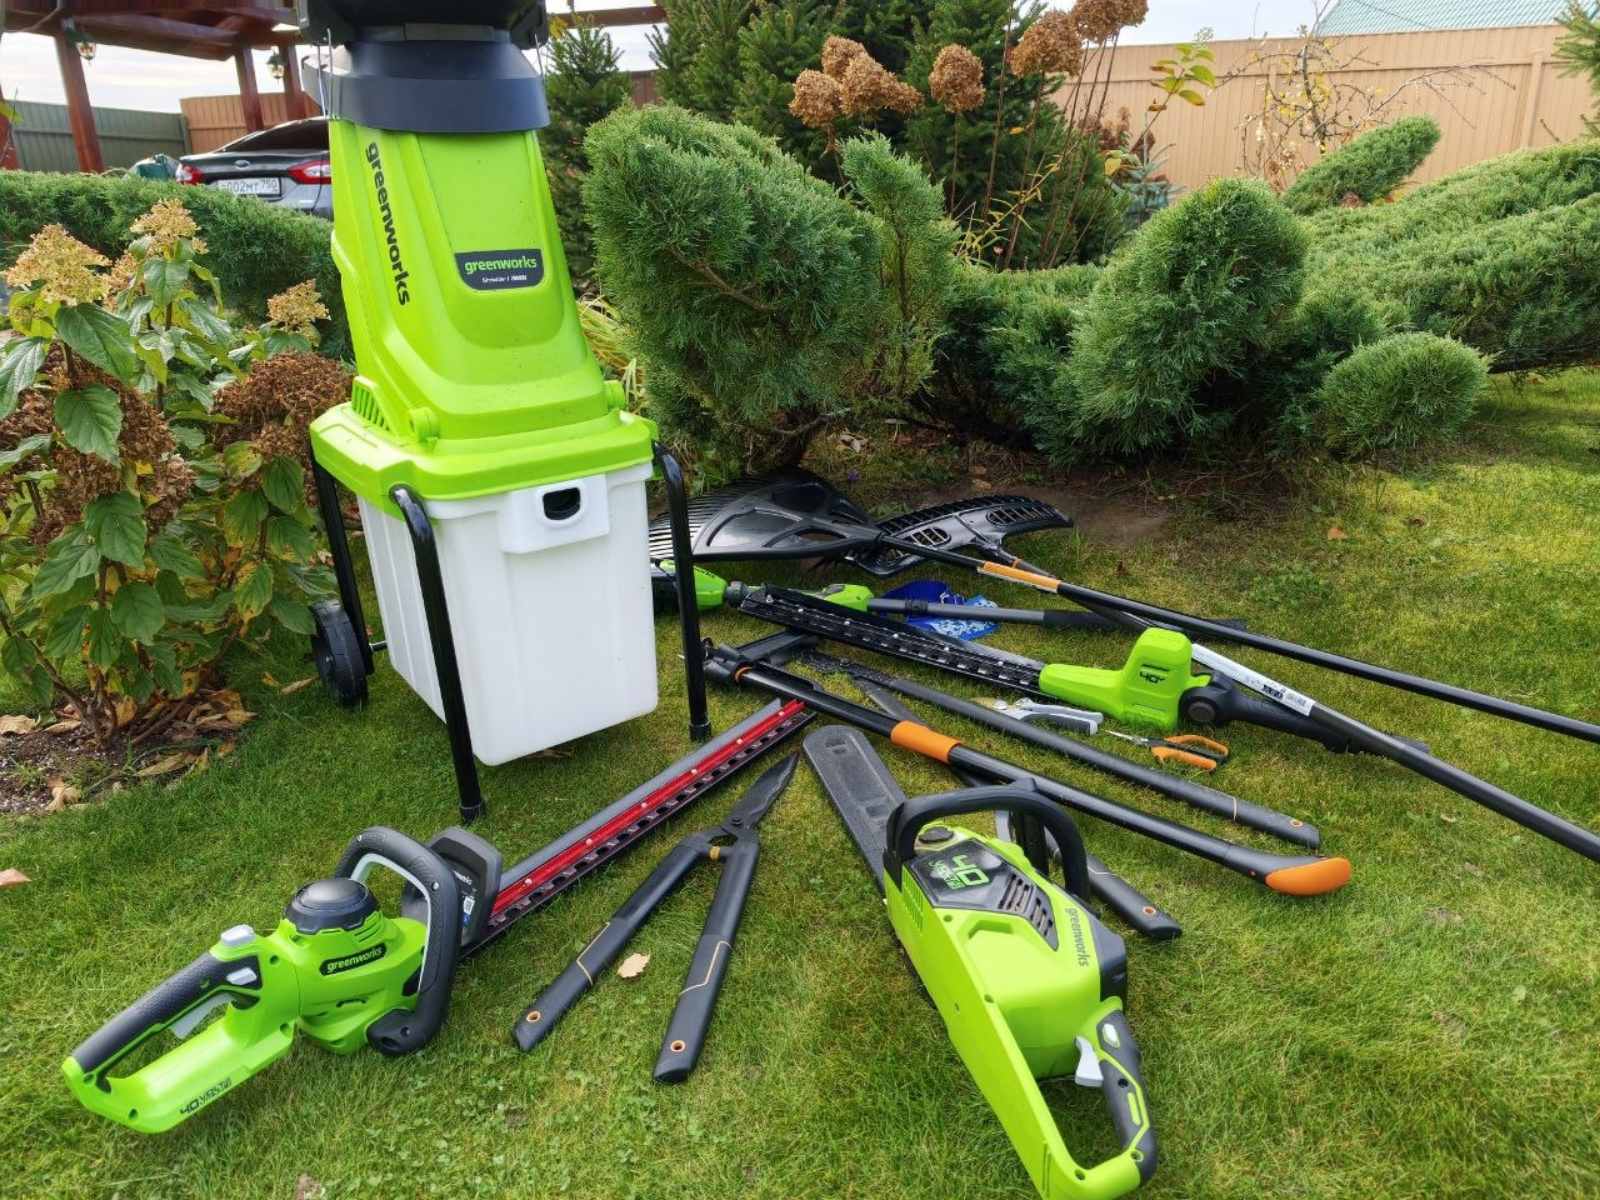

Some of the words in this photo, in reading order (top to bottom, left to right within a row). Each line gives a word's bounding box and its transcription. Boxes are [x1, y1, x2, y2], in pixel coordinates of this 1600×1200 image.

[366, 142, 410, 306] greenworks
[464, 255, 537, 275] greenworks
[951, 854, 990, 886] 40
[1065, 907, 1090, 967] greenworks
[327, 946, 383, 973] greenworks
